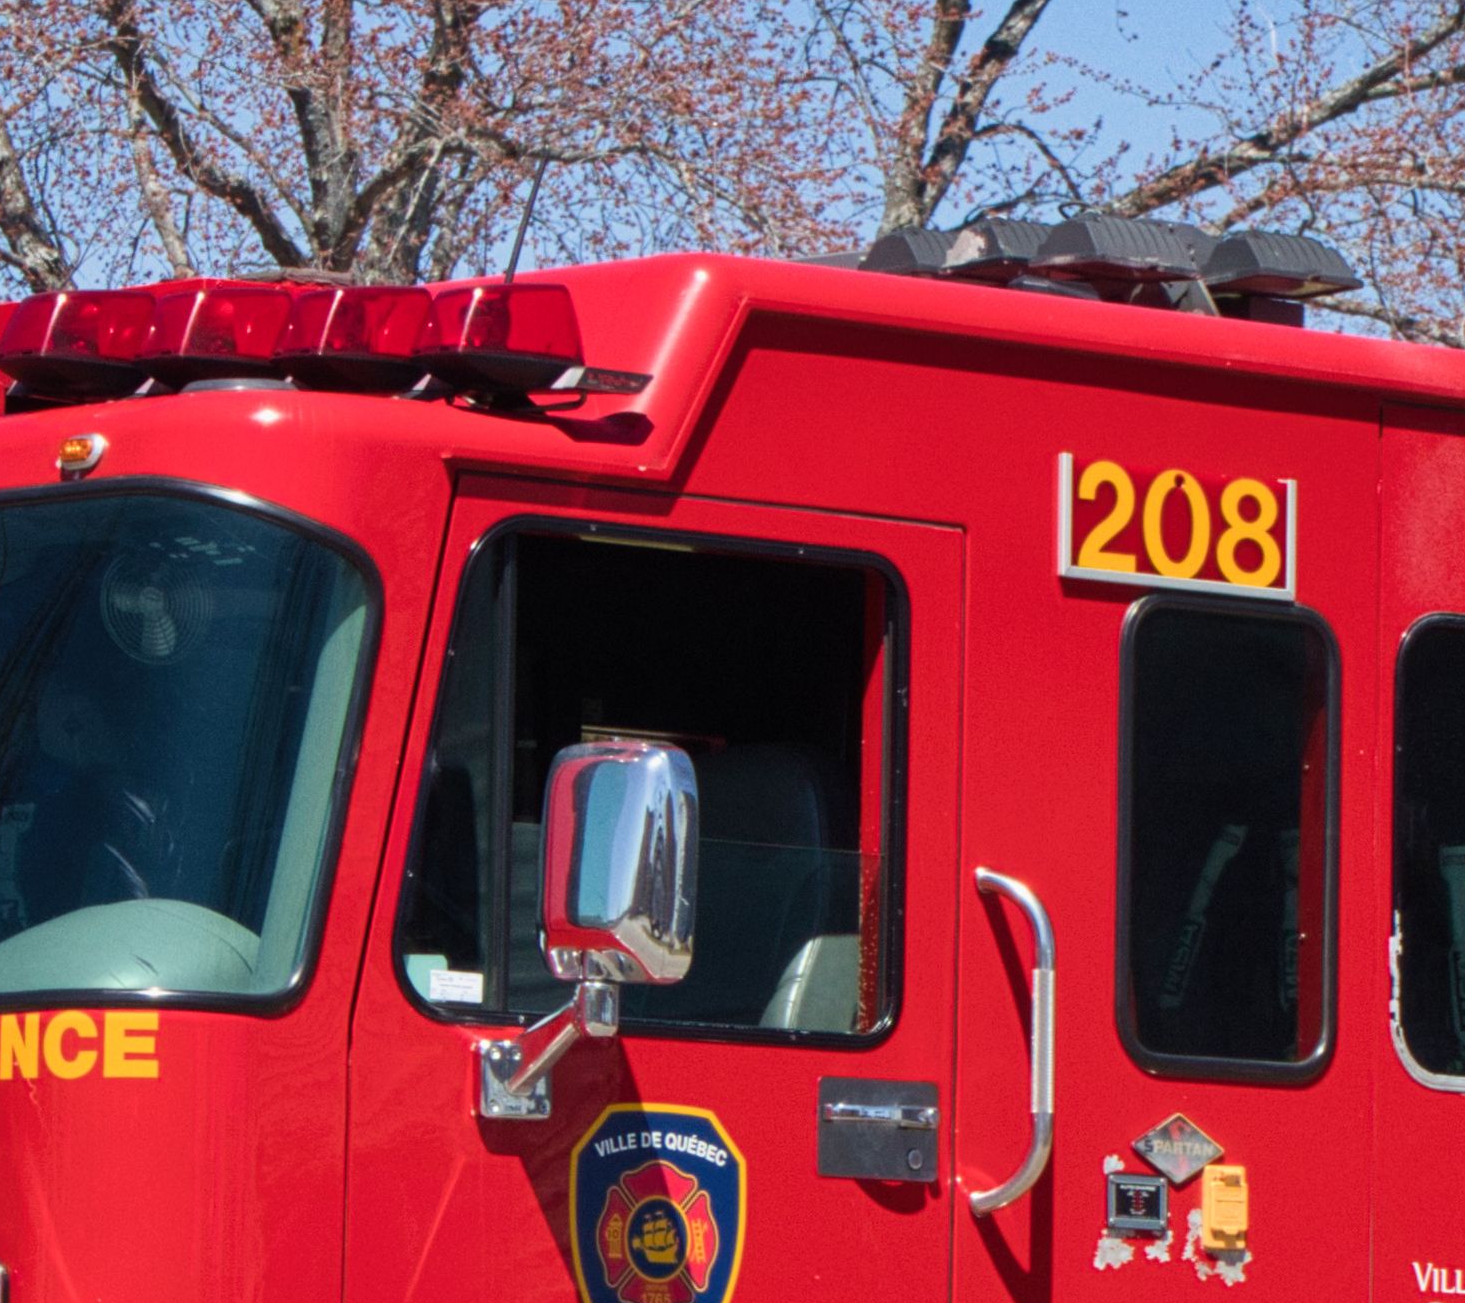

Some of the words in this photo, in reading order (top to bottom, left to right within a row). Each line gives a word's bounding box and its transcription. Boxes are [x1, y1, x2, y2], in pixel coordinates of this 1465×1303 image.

[1076, 459, 1282, 588] 208
[594, 1131, 638, 1158] VILLE
[640, 1131, 662, 1149] DE
[664, 1132, 728, 1168] QUÉBEC
[1143, 1135, 1215, 1157] SPARTAN
